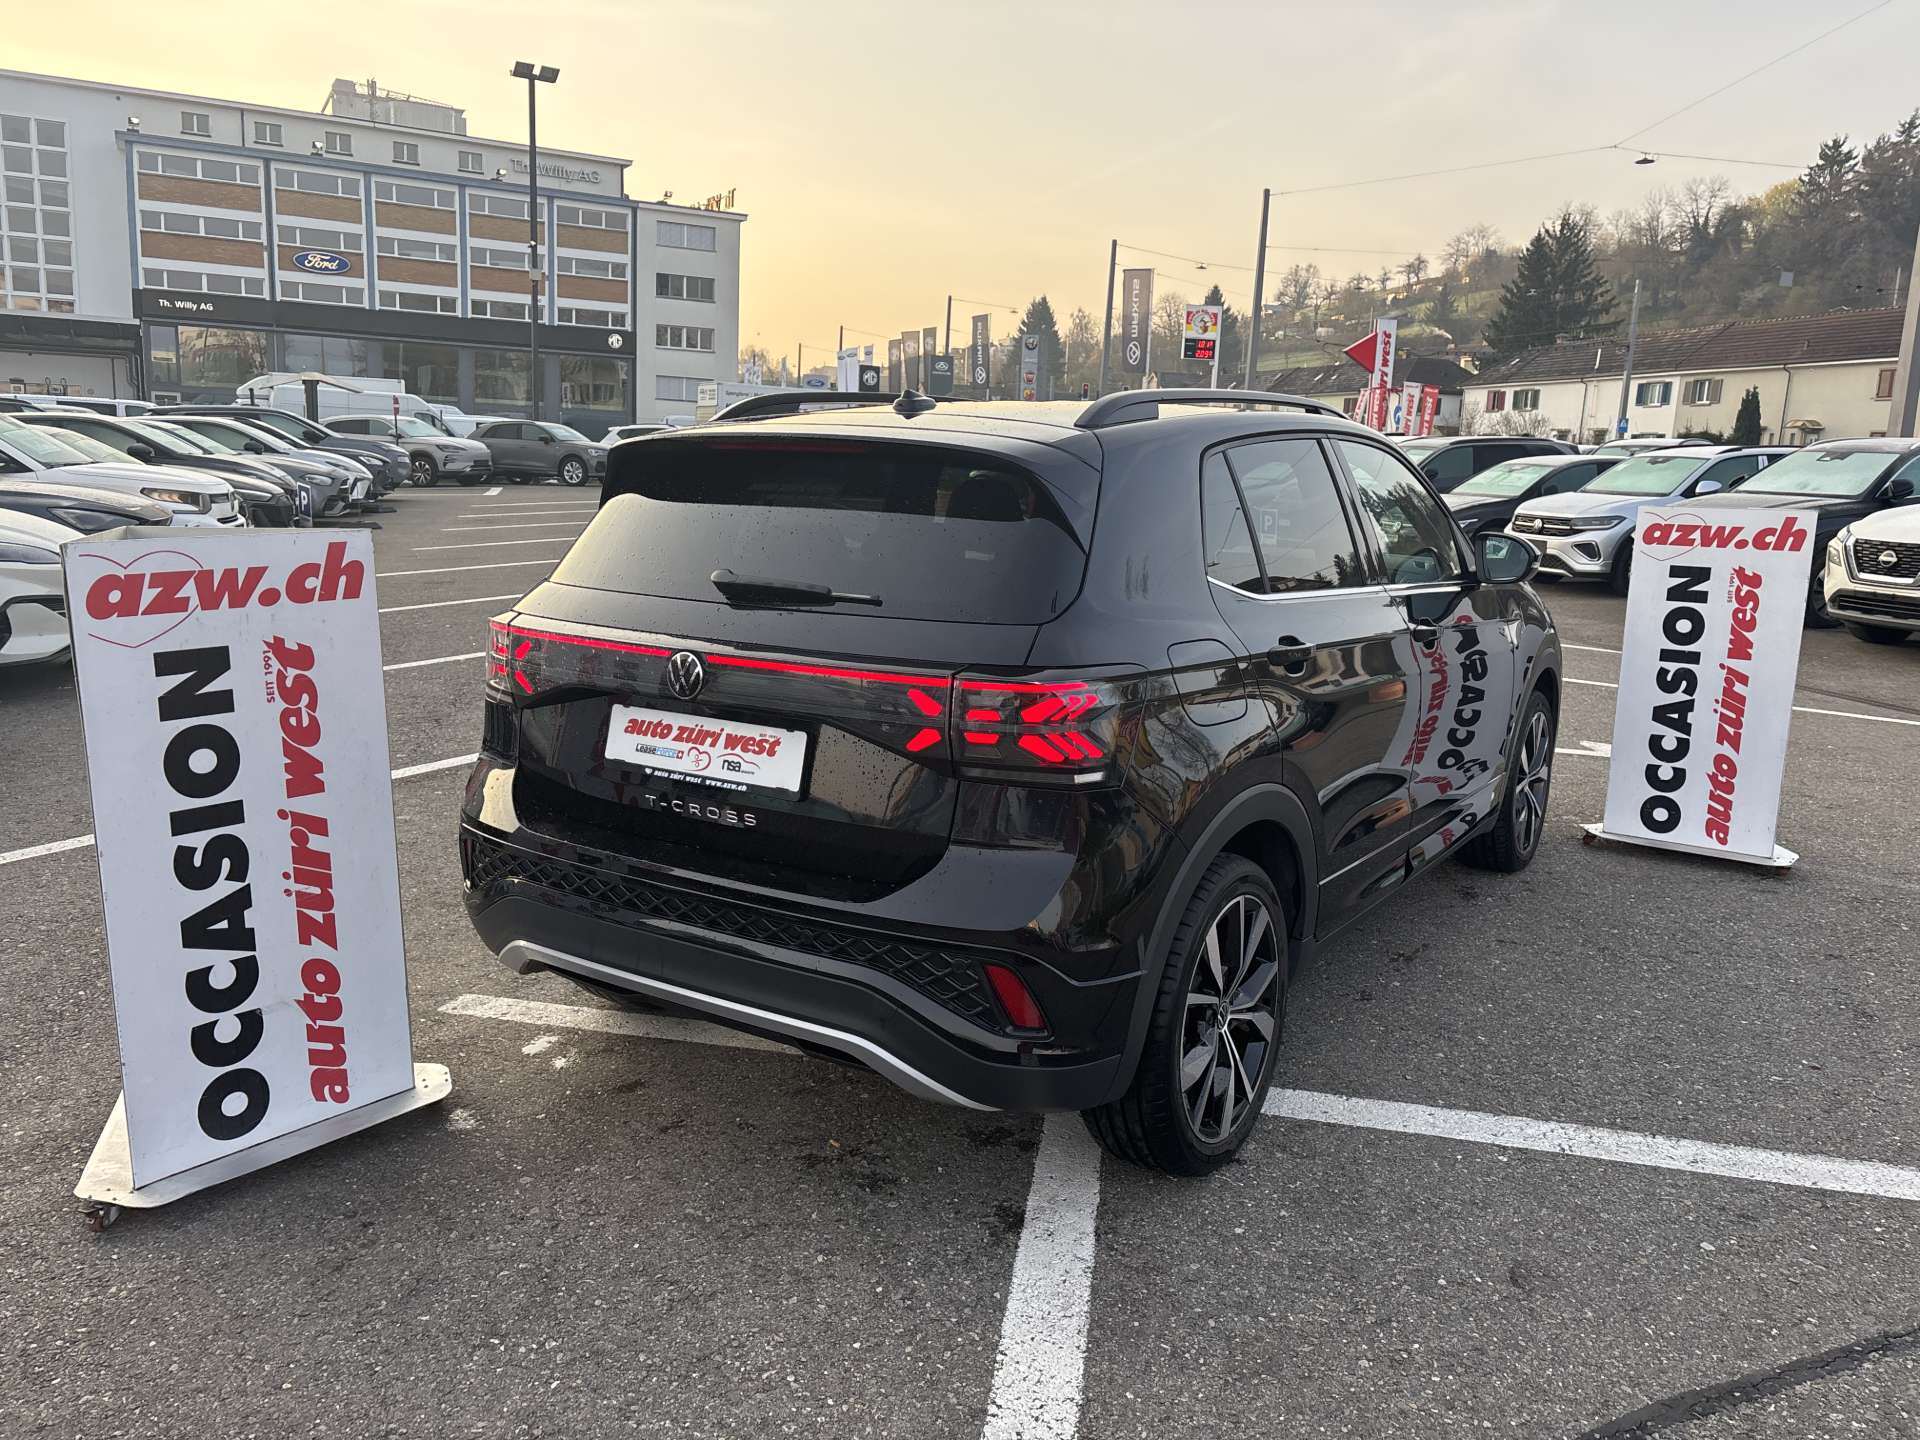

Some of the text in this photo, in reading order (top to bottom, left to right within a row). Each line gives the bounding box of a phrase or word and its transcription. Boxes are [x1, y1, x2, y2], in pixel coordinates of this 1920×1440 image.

[511, 158, 530, 173] Th
[579, 168, 601, 184] AG
[303, 253, 341, 271] Ford
[158, 299, 214, 312] Th. Willy AG
[1642, 516, 1807, 552] azw.ch
[86, 543, 365, 620] azw.ch
[262, 650, 276, 704] SEIT 1991
[1639, 564, 1712, 835] OCCASION
[1706, 564, 1763, 846] auto züri west
[624, 717, 782, 757] auto züri west
[721, 759, 742, 773] nsa
[644, 793, 758, 827] T-CROSS
[262, 634, 350, 1105] auto züri west
[153, 645, 271, 1141] OCCASION
